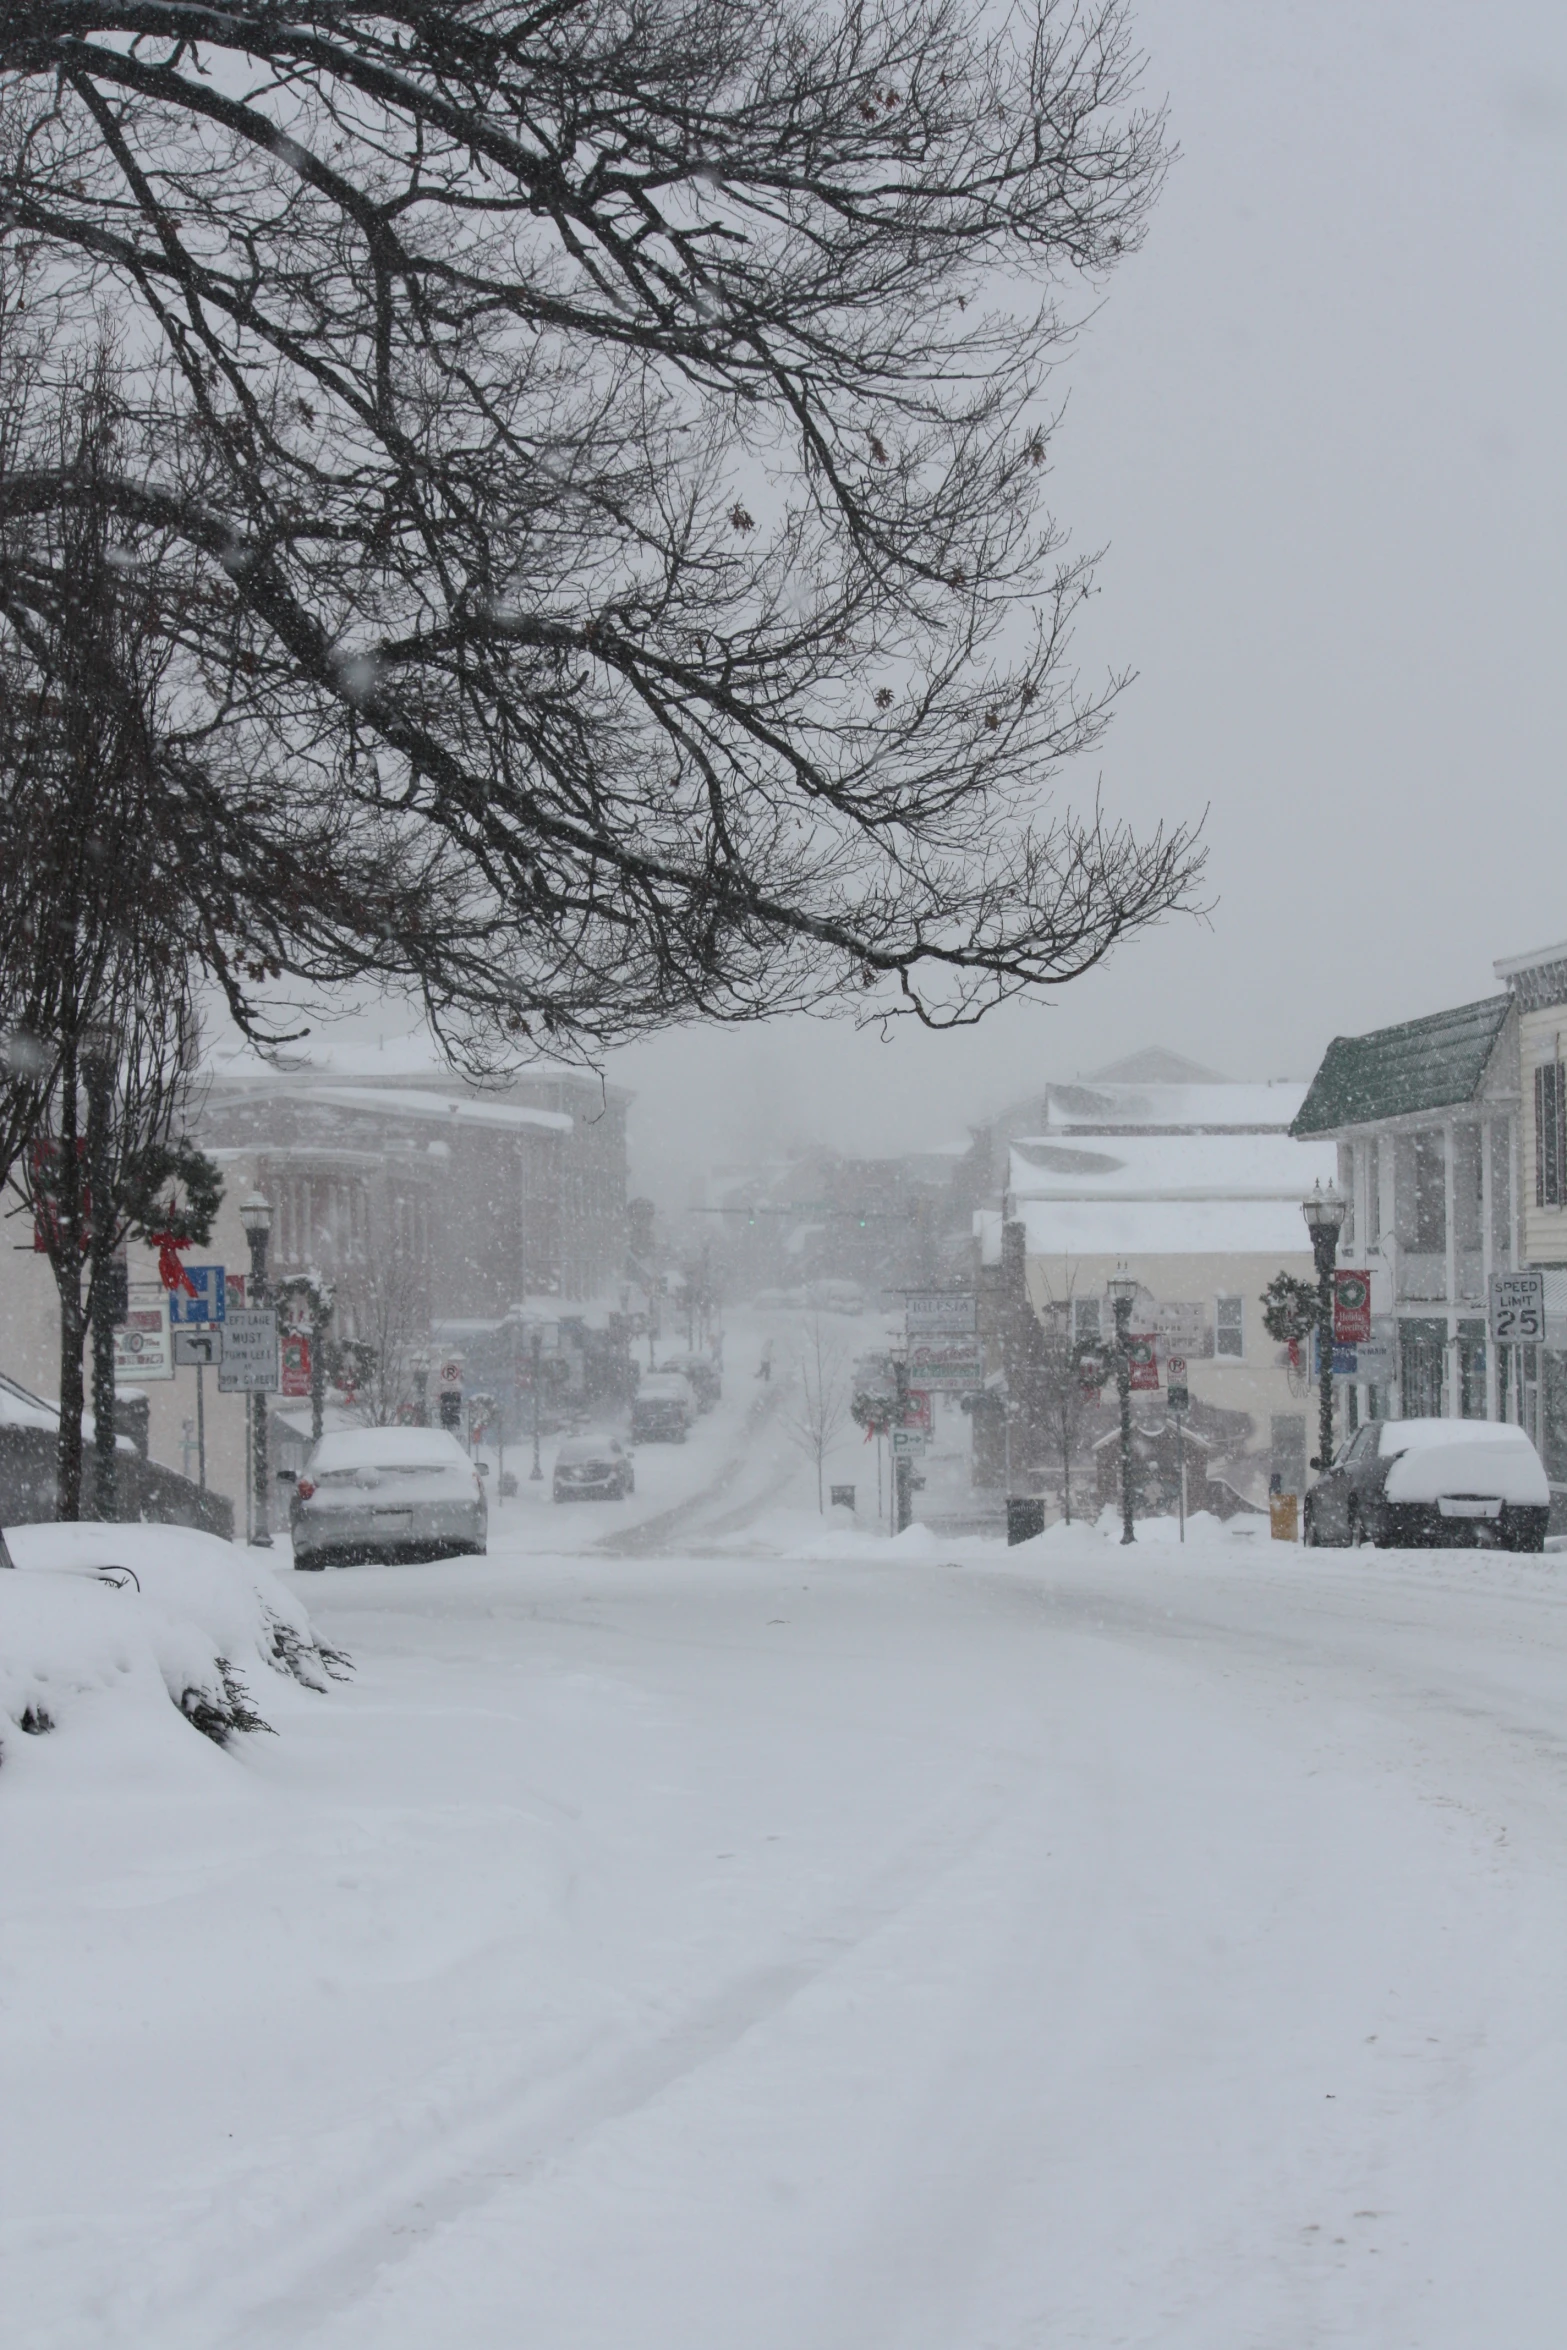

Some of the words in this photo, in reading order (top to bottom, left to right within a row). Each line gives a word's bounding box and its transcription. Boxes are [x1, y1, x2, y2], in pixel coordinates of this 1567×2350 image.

[1495, 1281, 1538, 1293] SPEED
[178, 1269, 217, 1319] H
[1500, 1295, 1533, 1307] LIMIT
[248, 1315, 271, 1326] LANE
[1497, 1309, 1539, 1336] 25
[232, 1332, 262, 1344] MUST
[224, 1350, 248, 1360] TURN
[250, 1350, 271, 1360] LEFT
